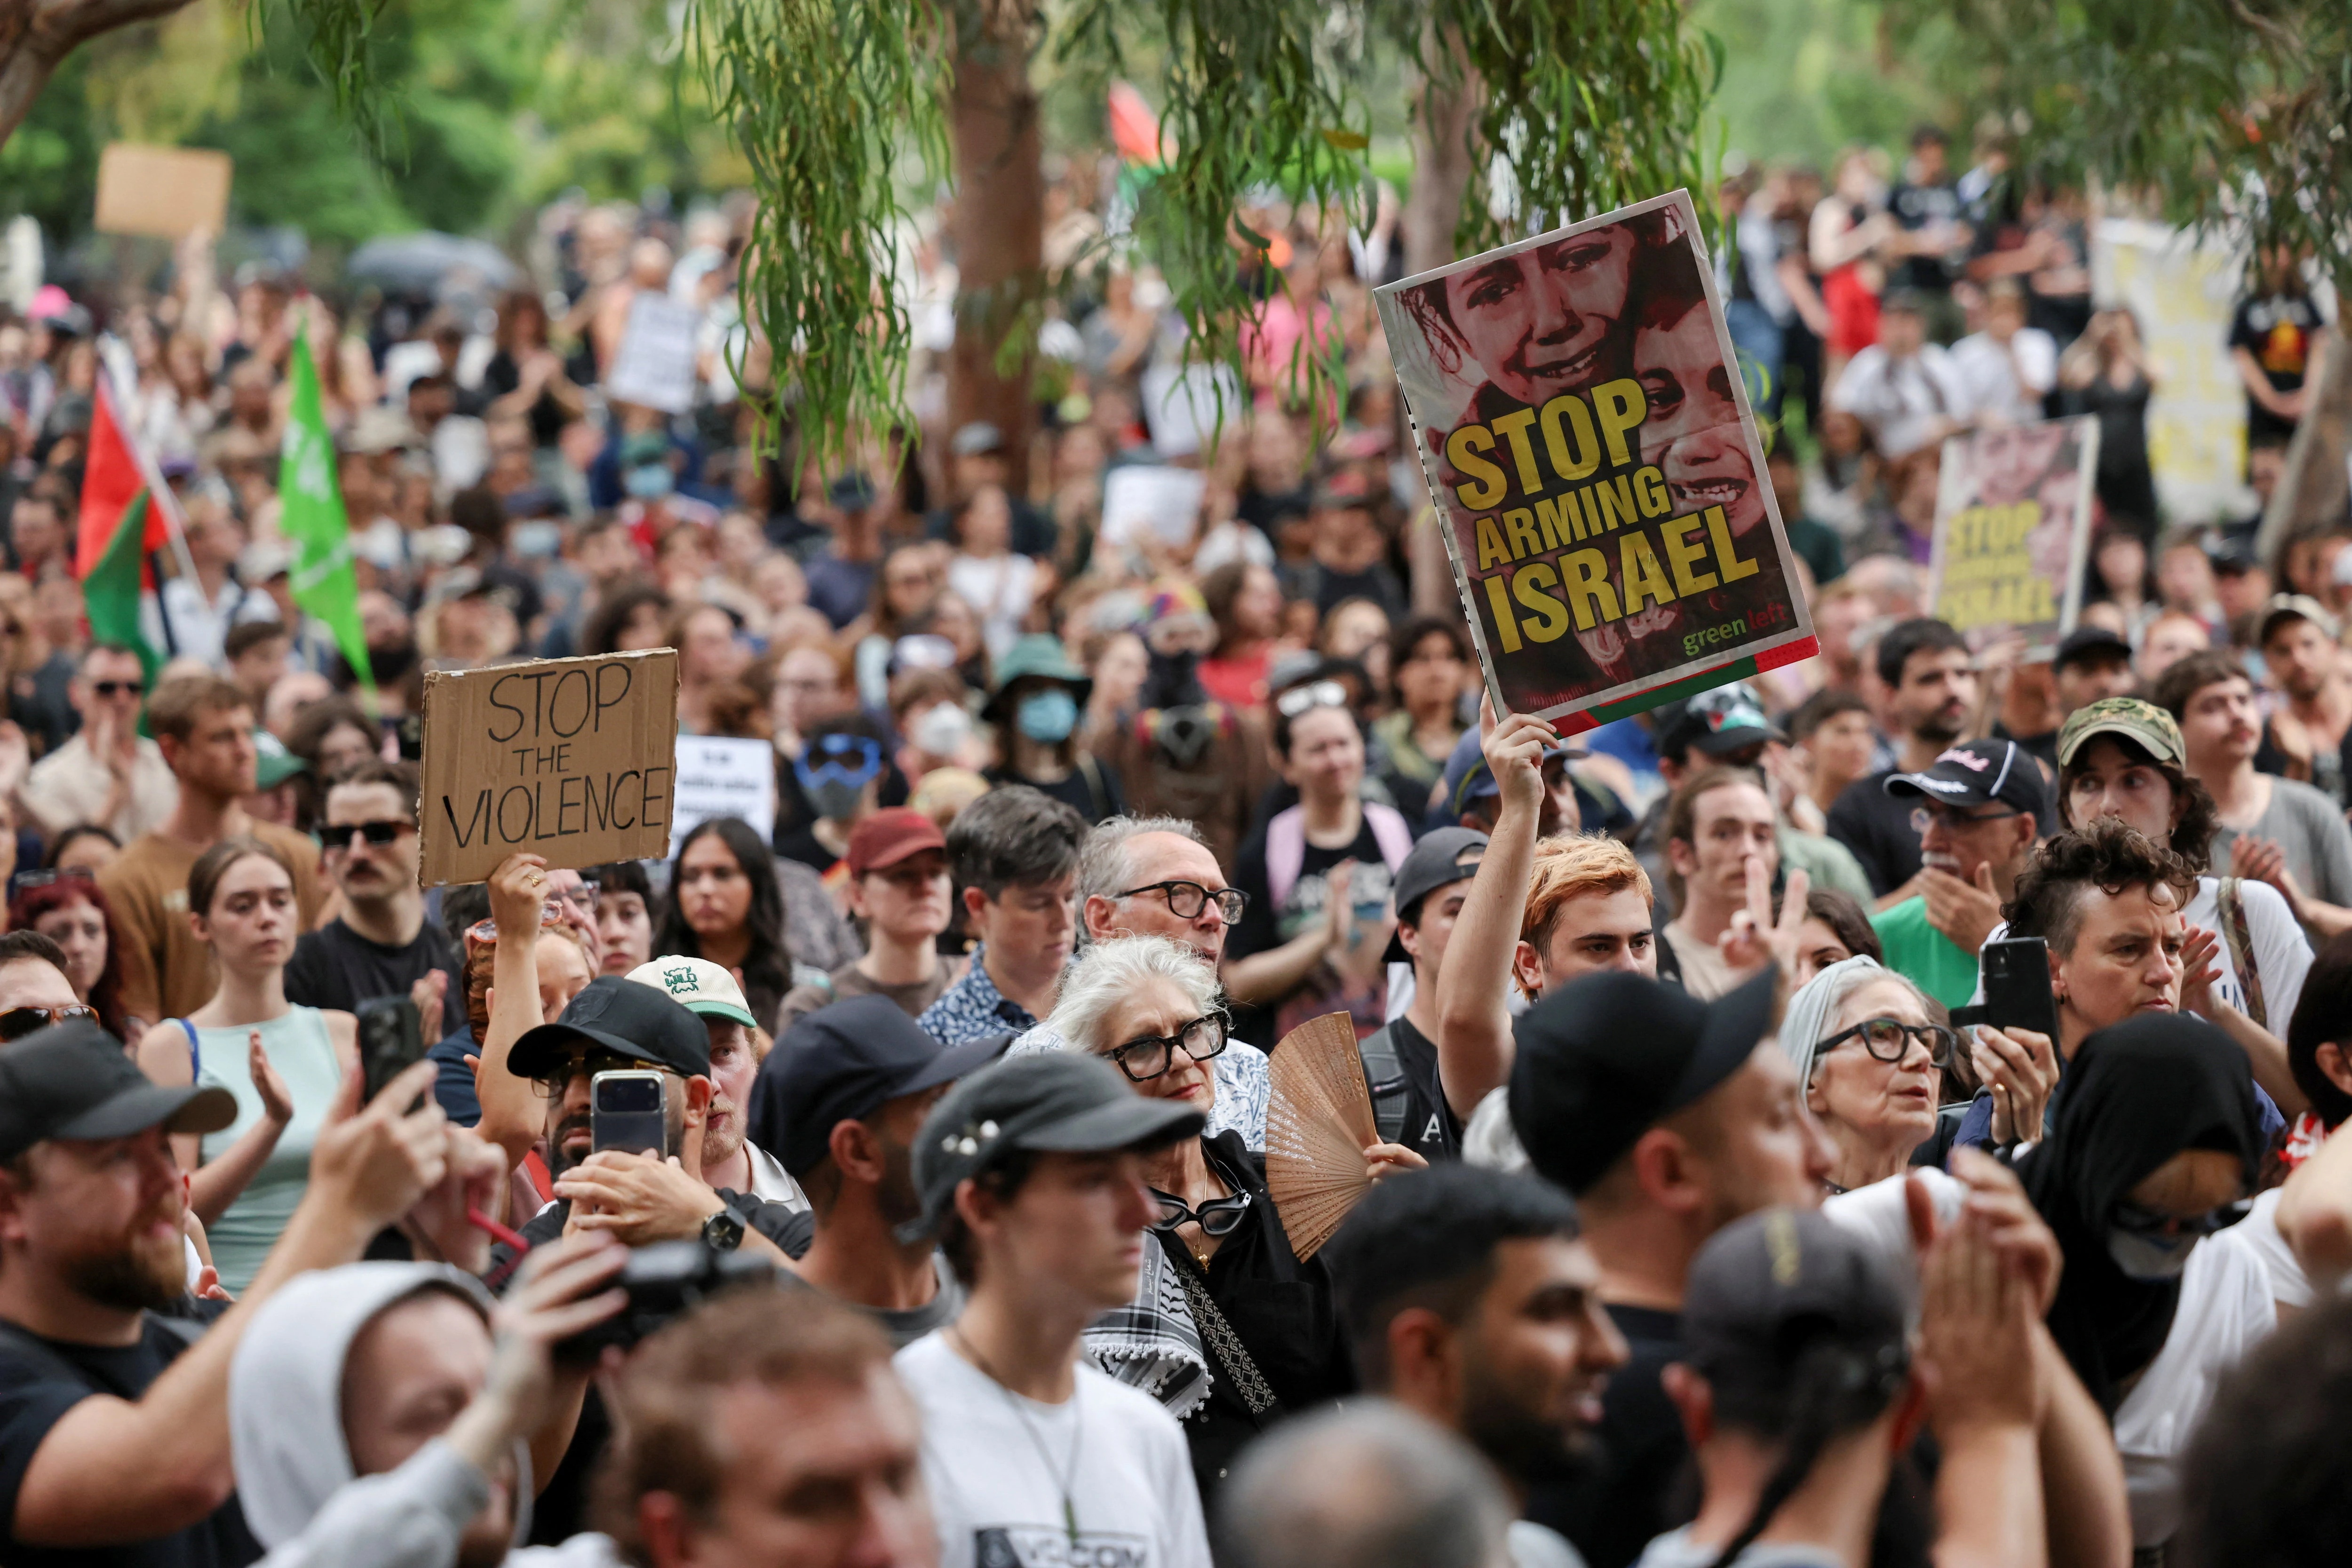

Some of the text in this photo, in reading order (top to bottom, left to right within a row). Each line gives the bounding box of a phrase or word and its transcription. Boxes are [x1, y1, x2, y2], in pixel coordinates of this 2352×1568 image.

[1446, 378, 1647, 510] STOP
[1476, 465, 1672, 571] ARMING
[1483, 505, 1760, 654] ISRAEL
[1683, 602, 1788, 657] green left
[488, 662, 632, 742] STOP
[512, 743, 571, 776] THE
[443, 767, 669, 848] VIOLENCE
